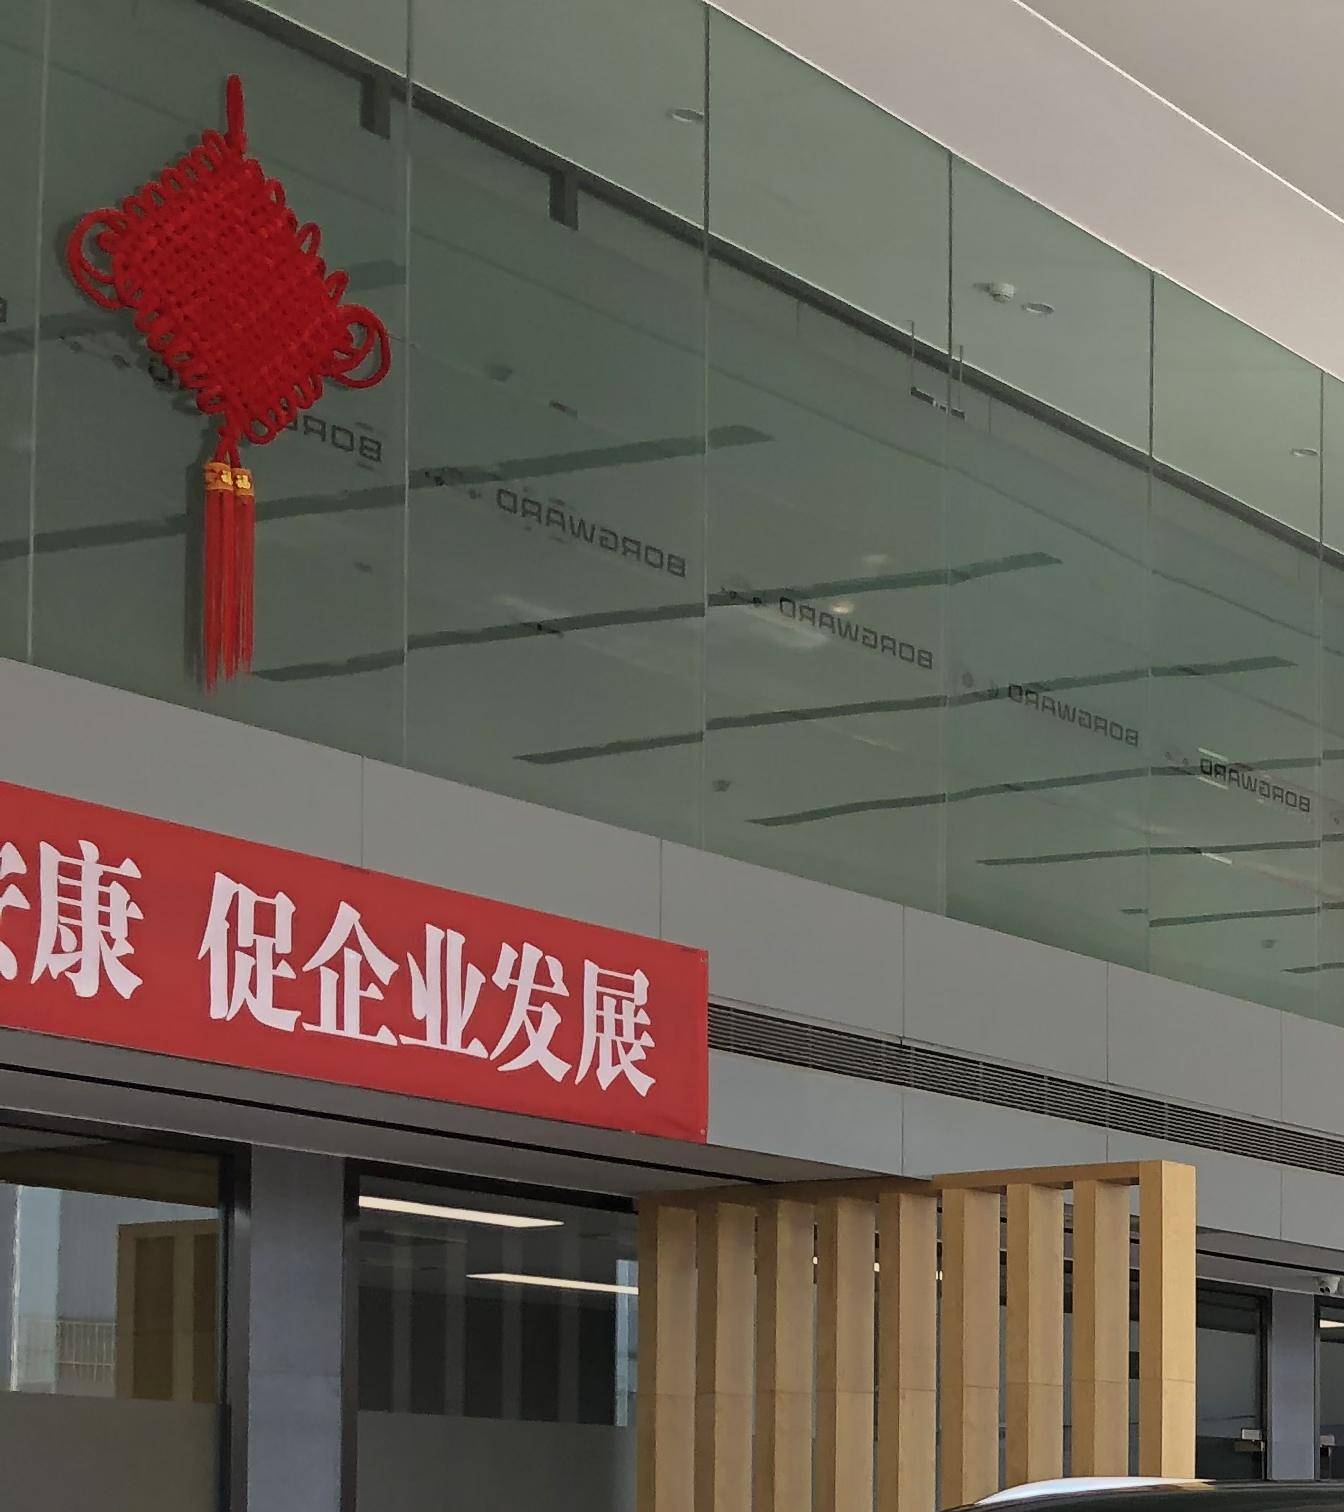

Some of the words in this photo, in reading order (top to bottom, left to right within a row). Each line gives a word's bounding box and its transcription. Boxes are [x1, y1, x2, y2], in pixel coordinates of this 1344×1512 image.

[0, 840, 144, 1000] 康
[198, 871, 657, 1098] 促企业发展
